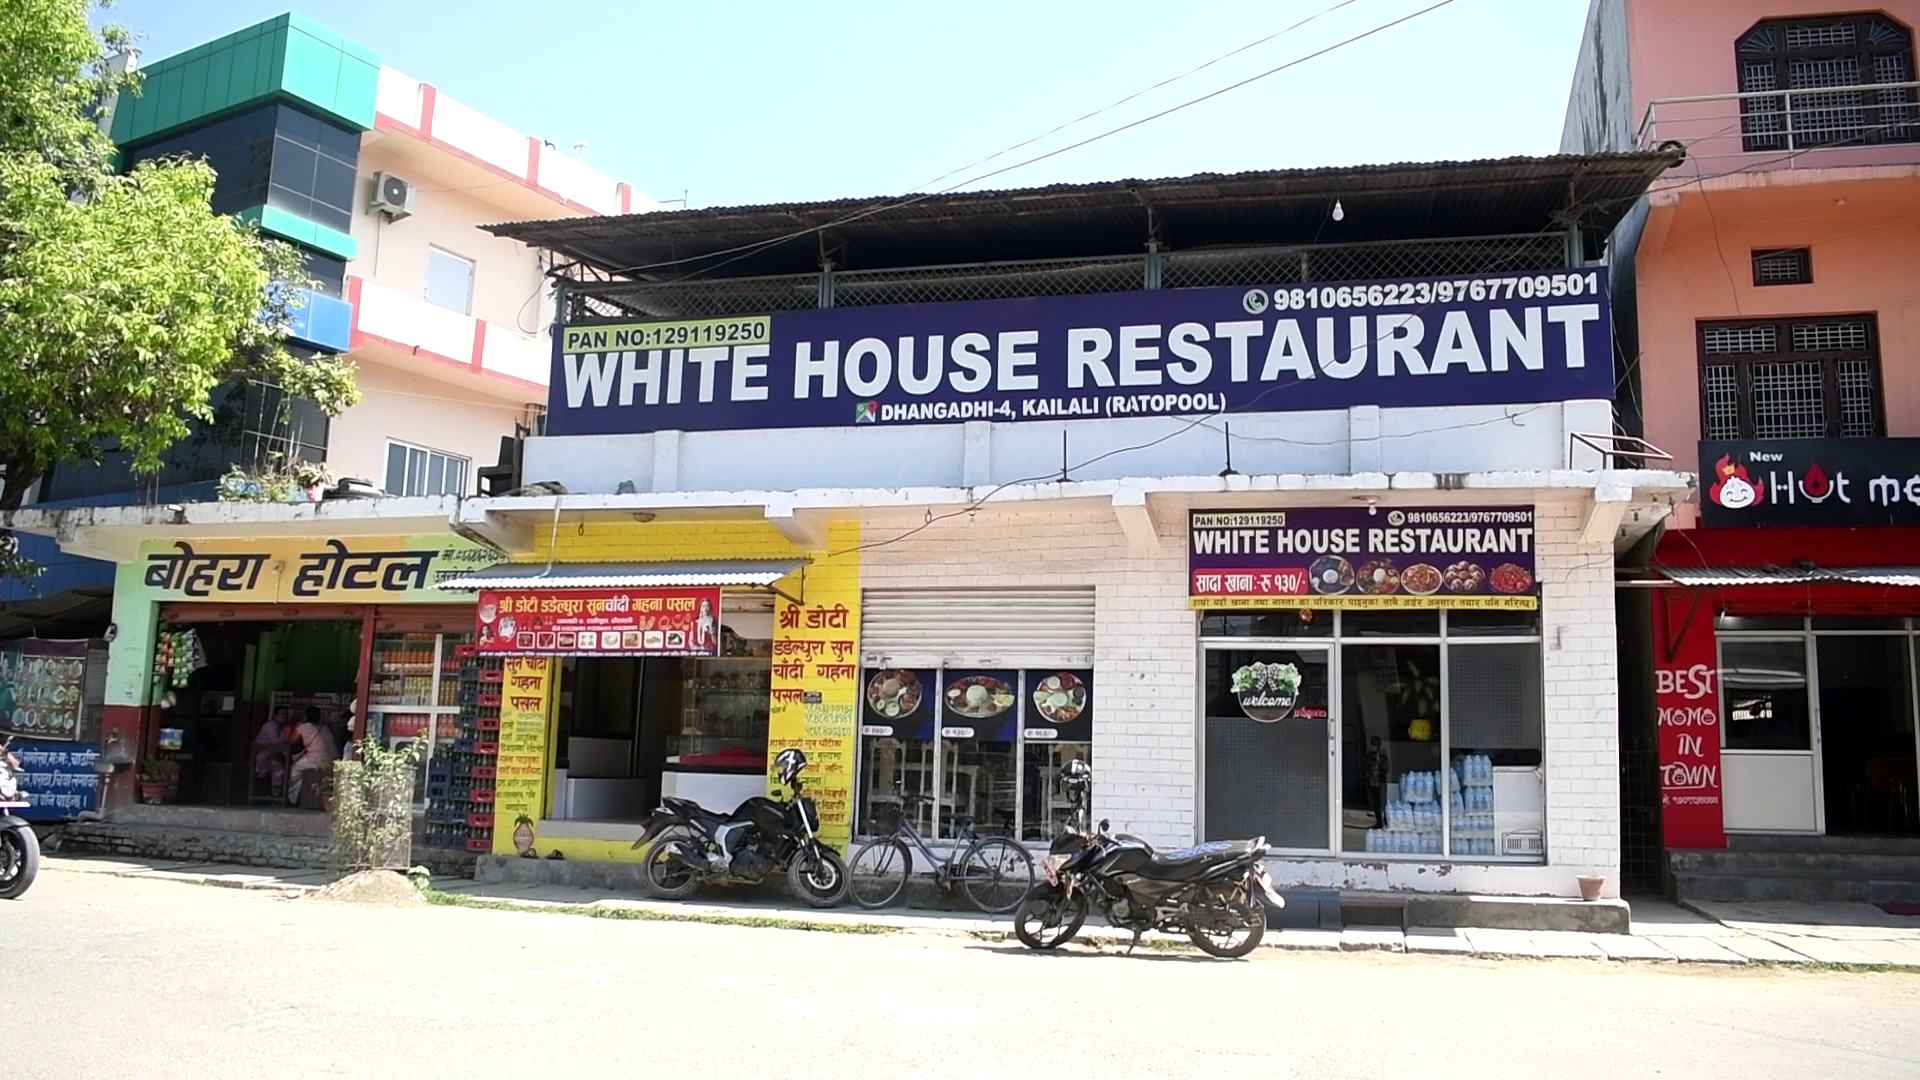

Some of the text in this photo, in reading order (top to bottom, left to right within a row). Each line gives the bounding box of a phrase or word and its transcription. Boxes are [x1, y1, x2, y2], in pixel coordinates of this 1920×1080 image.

[1275, 273, 1598, 310] 9810656223/9767709501
[568, 321, 766, 349] PAN NO:129119250
[563, 304, 1600, 408] WHITE HOUSE RESTAURANT
[881, 392, 1226, 421] DHANGADHI-4, KAILALI (RATOPOOL)
[1750, 451, 1783, 462] New
[1195, 515, 1284, 526] PAN NO:129119250
[1408, 511, 1532, 523] 9810656223/9767709501
[1193, 528, 1533, 554] WHITE HOUSE RESTAURANT
[144, 539, 439, 597] बोहरा होटल
[1196, 574, 1221, 592] सादा
[499, 597, 512, 614] श्री
[515, 596, 537, 613] डोटी
[632, 598, 663, 613] गहना
[666, 597, 696, 612] पसल
[779, 603, 849, 629] श्री डोटी
[830, 641, 854, 662] सुन
[816, 664, 856, 682] गहना
[1655, 664, 1715, 699] BEST
[511, 676, 542, 692] गहना
[510, 696, 542, 711] पसल
[771, 689, 804, 704] पसल
[1243, 691, 1292, 707] welcome
[1677, 733, 1704, 757] IN
[1660, 762, 1718, 789] TOWN
